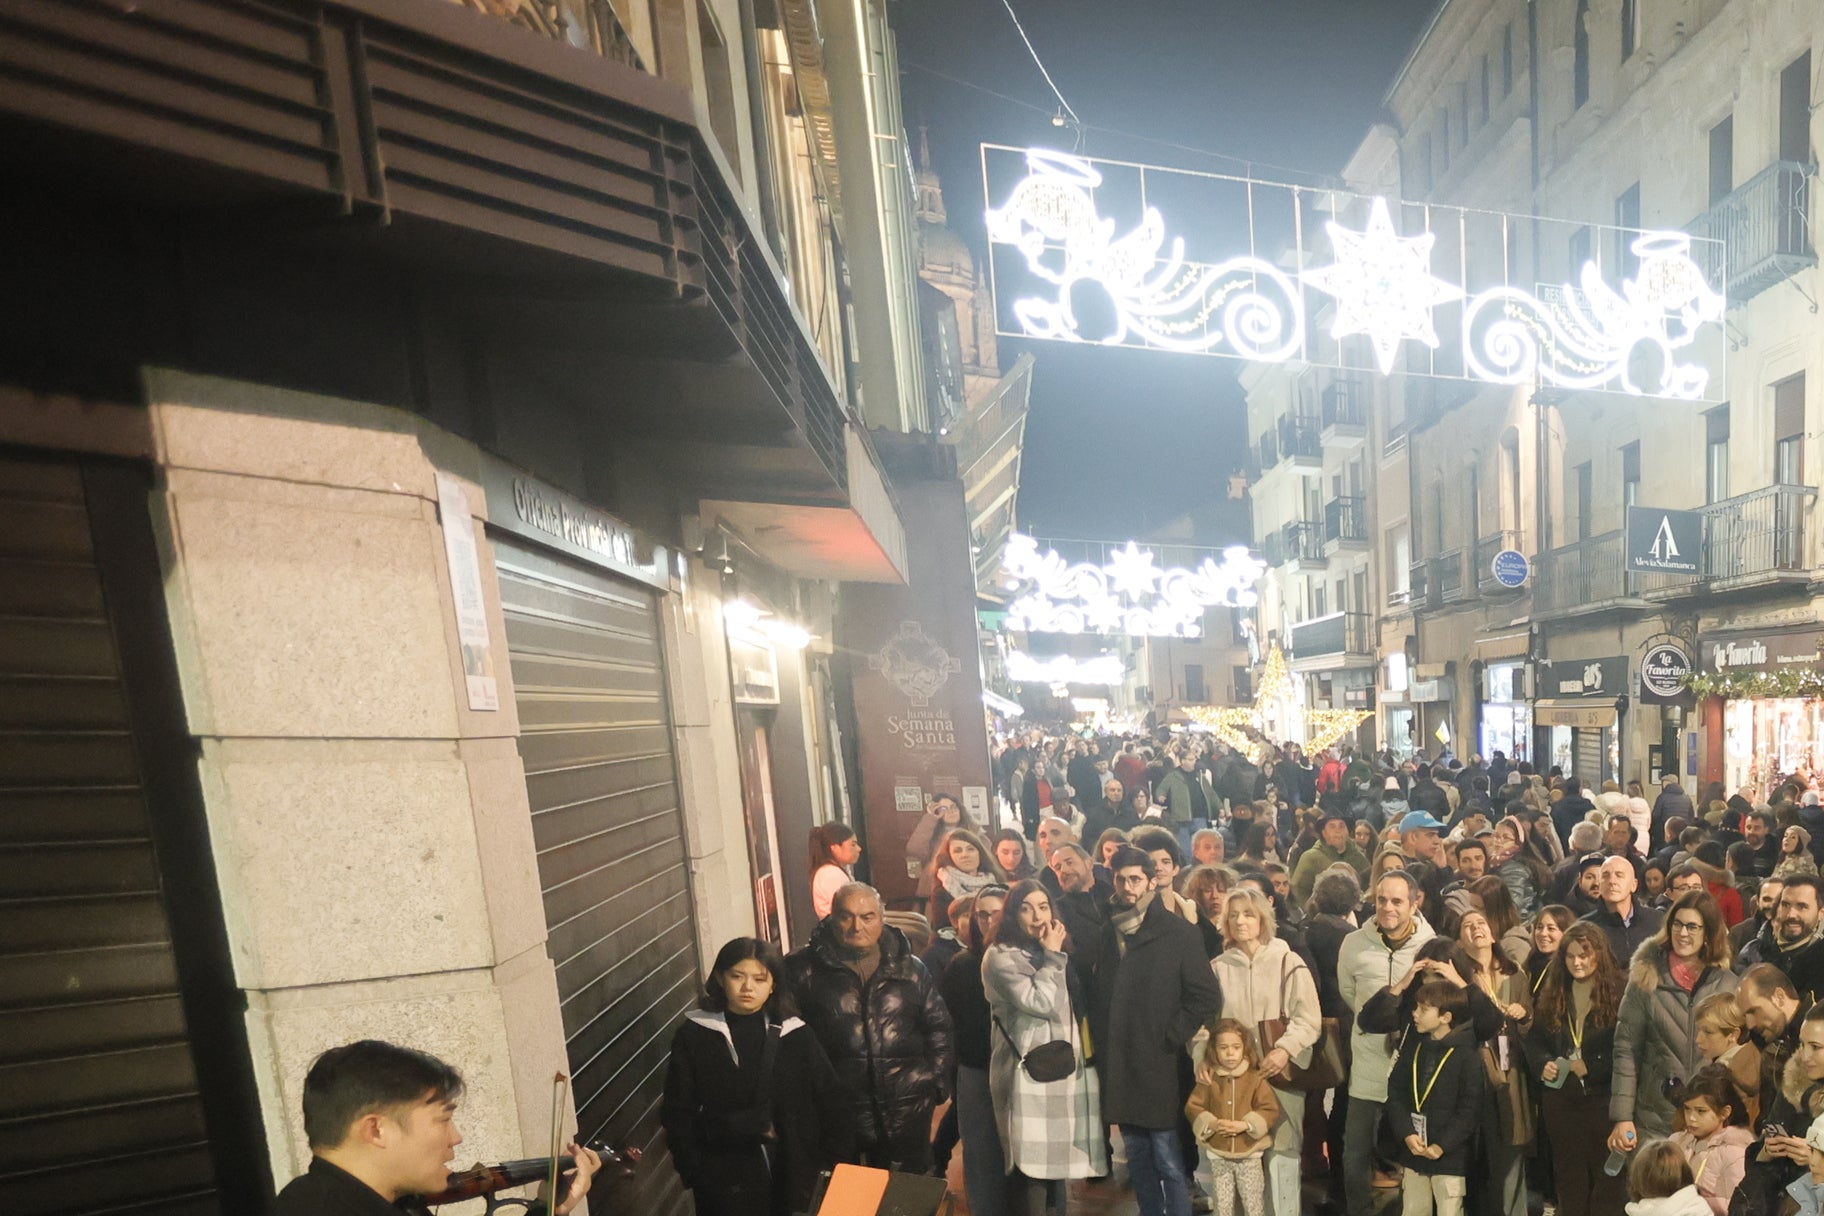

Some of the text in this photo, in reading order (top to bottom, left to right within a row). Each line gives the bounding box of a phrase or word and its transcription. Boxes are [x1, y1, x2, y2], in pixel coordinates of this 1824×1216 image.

[512, 477, 560, 537] Oficina
[560, 501, 611, 560] Provincial
[1659, 652, 1673, 667] La
[1726, 640, 1768, 667] Favorita
[1646, 663, 1687, 676] Favorita
[887, 715, 955, 734] Semana
[903, 731, 956, 749] Santa
